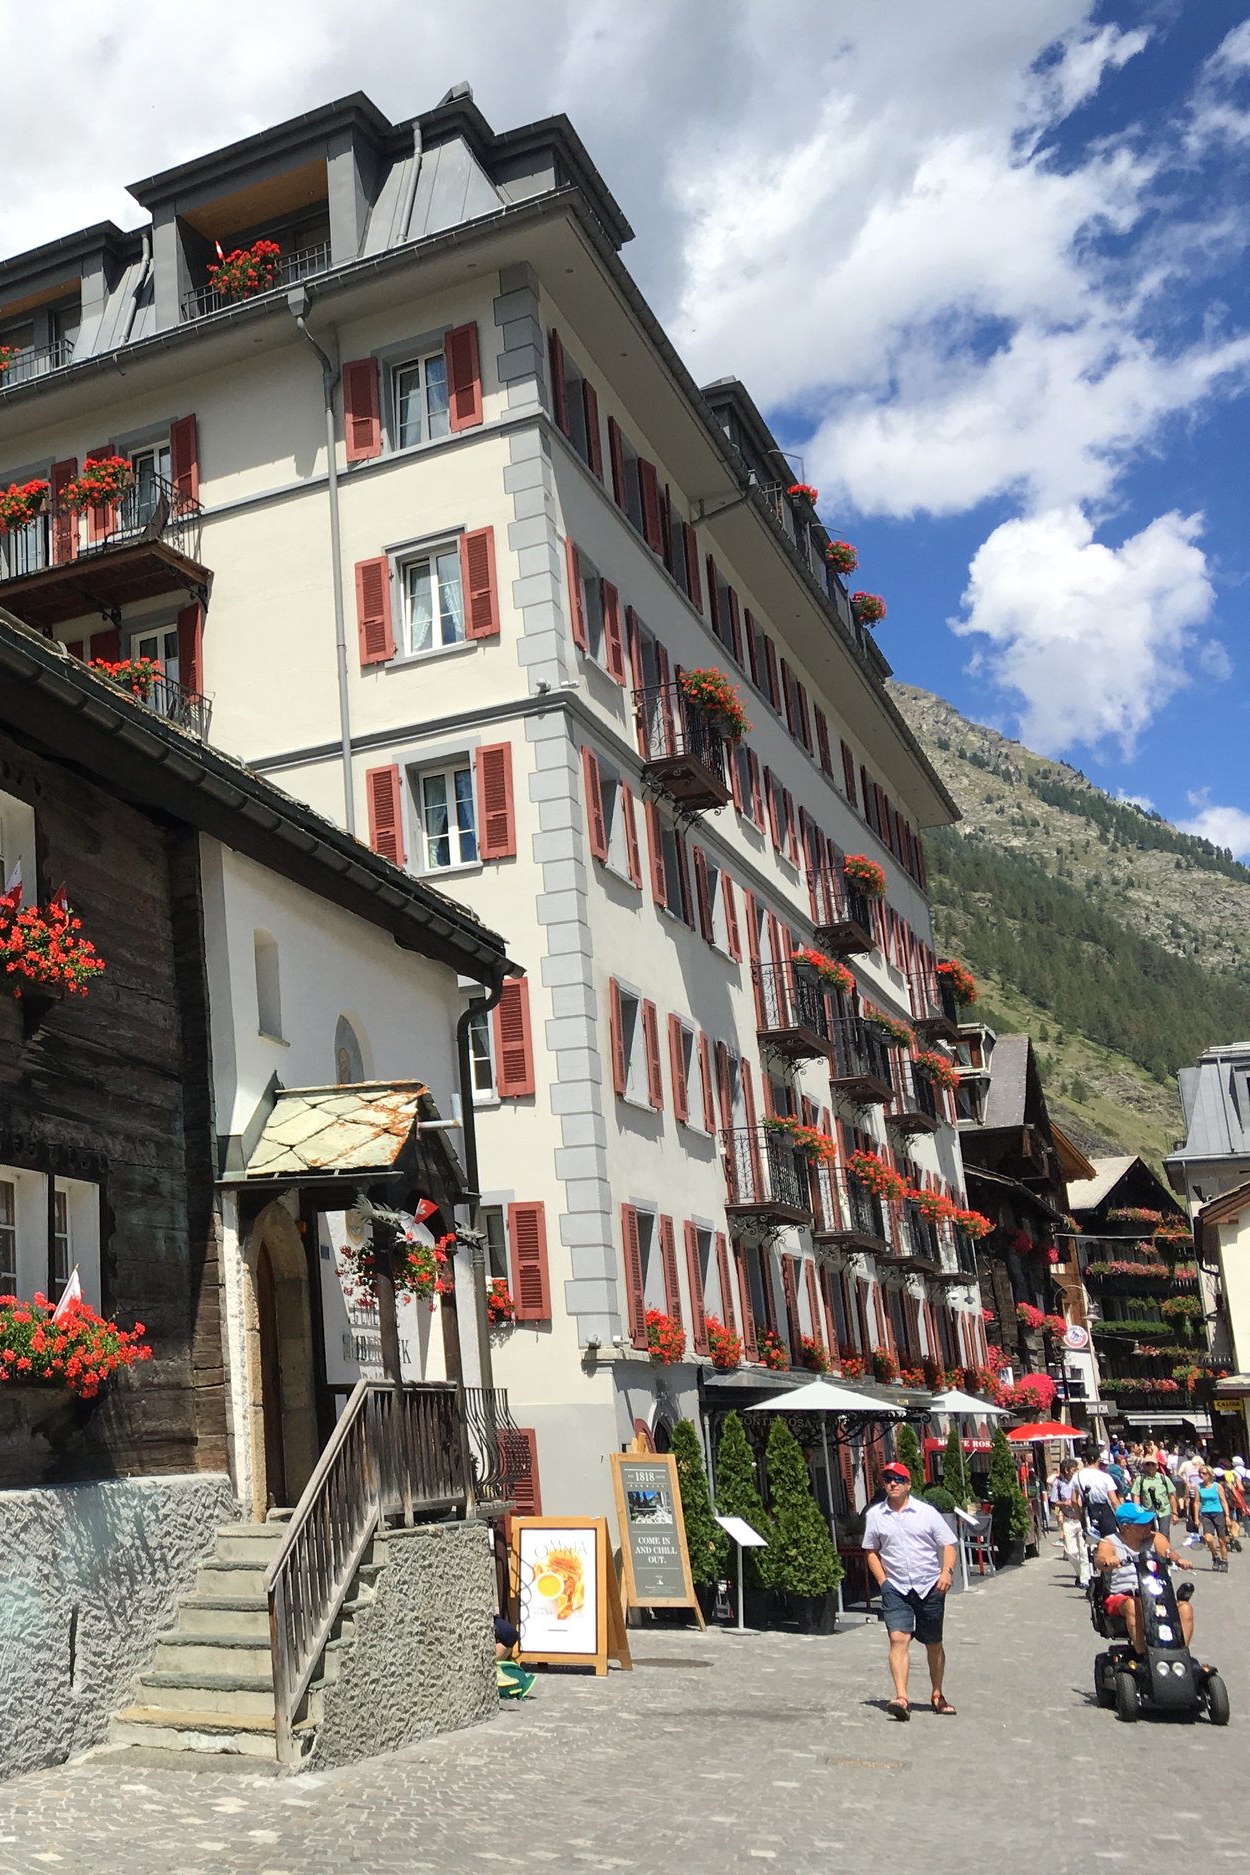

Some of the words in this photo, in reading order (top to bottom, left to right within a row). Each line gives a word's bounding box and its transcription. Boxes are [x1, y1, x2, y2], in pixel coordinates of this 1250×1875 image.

[635, 1471, 655, 1482] 1818
[638, 1536, 661, 1545] COME
[662, 1536, 671, 1545] IN
[535, 1540, 587, 1559] OMNIA
[635, 1546, 652, 1555] AND
[653, 1546, 677, 1555] CHILL
[648, 1556, 667, 1564] OUT.
